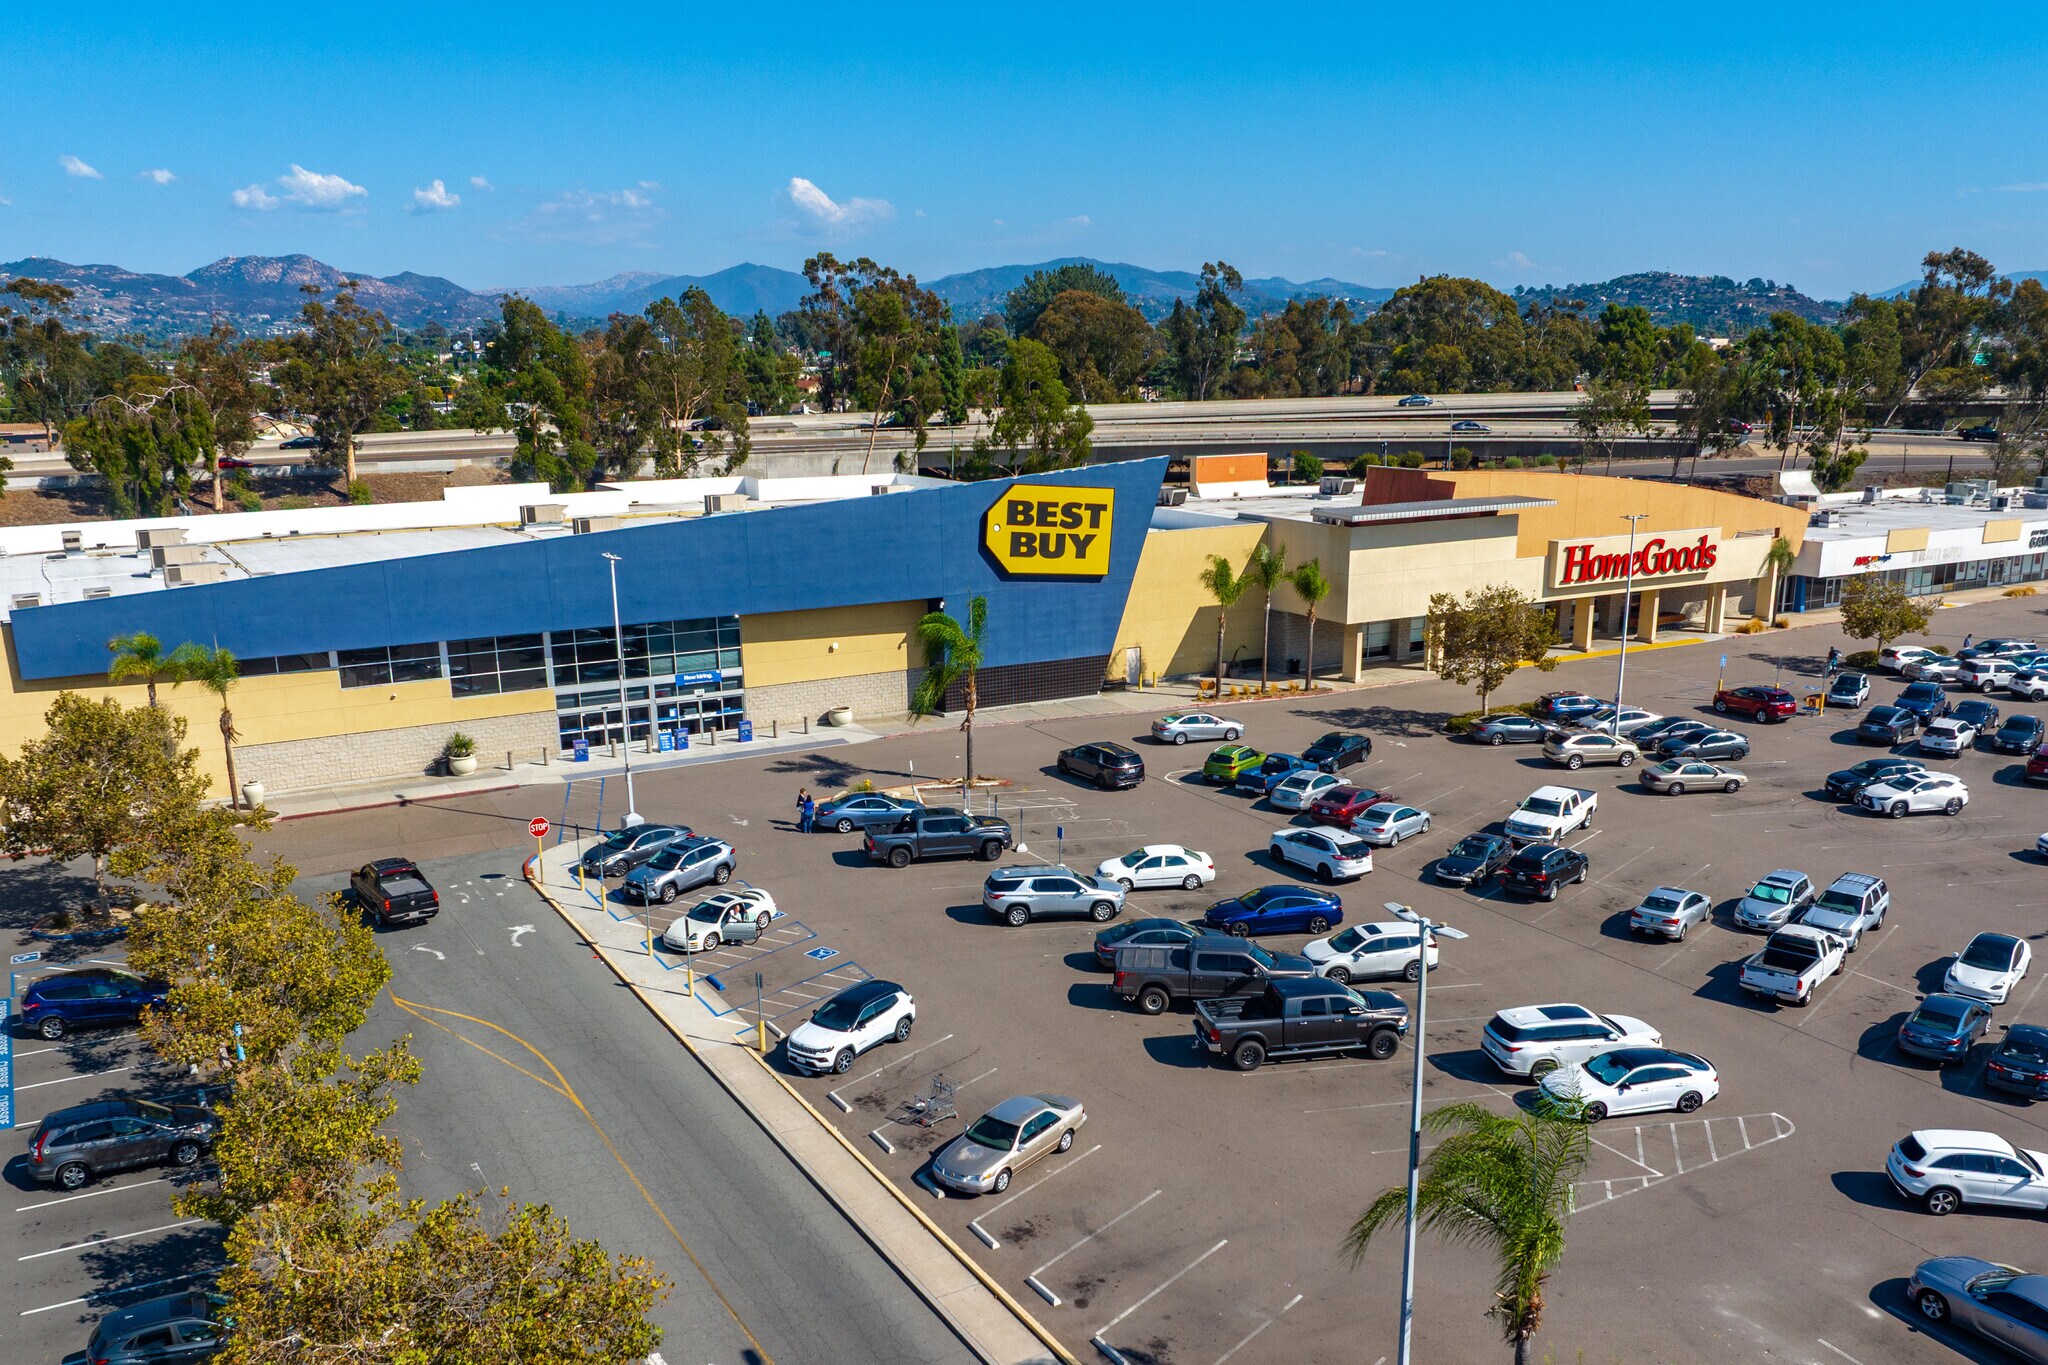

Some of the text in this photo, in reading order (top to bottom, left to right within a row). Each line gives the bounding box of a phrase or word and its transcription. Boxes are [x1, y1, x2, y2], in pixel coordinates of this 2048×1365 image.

[1007, 499, 1107, 529] BEST
[1010, 532, 1097, 559] BUY
[1561, 535, 1717, 583] HomeGoods
[531, 822, 548, 832] STOP
